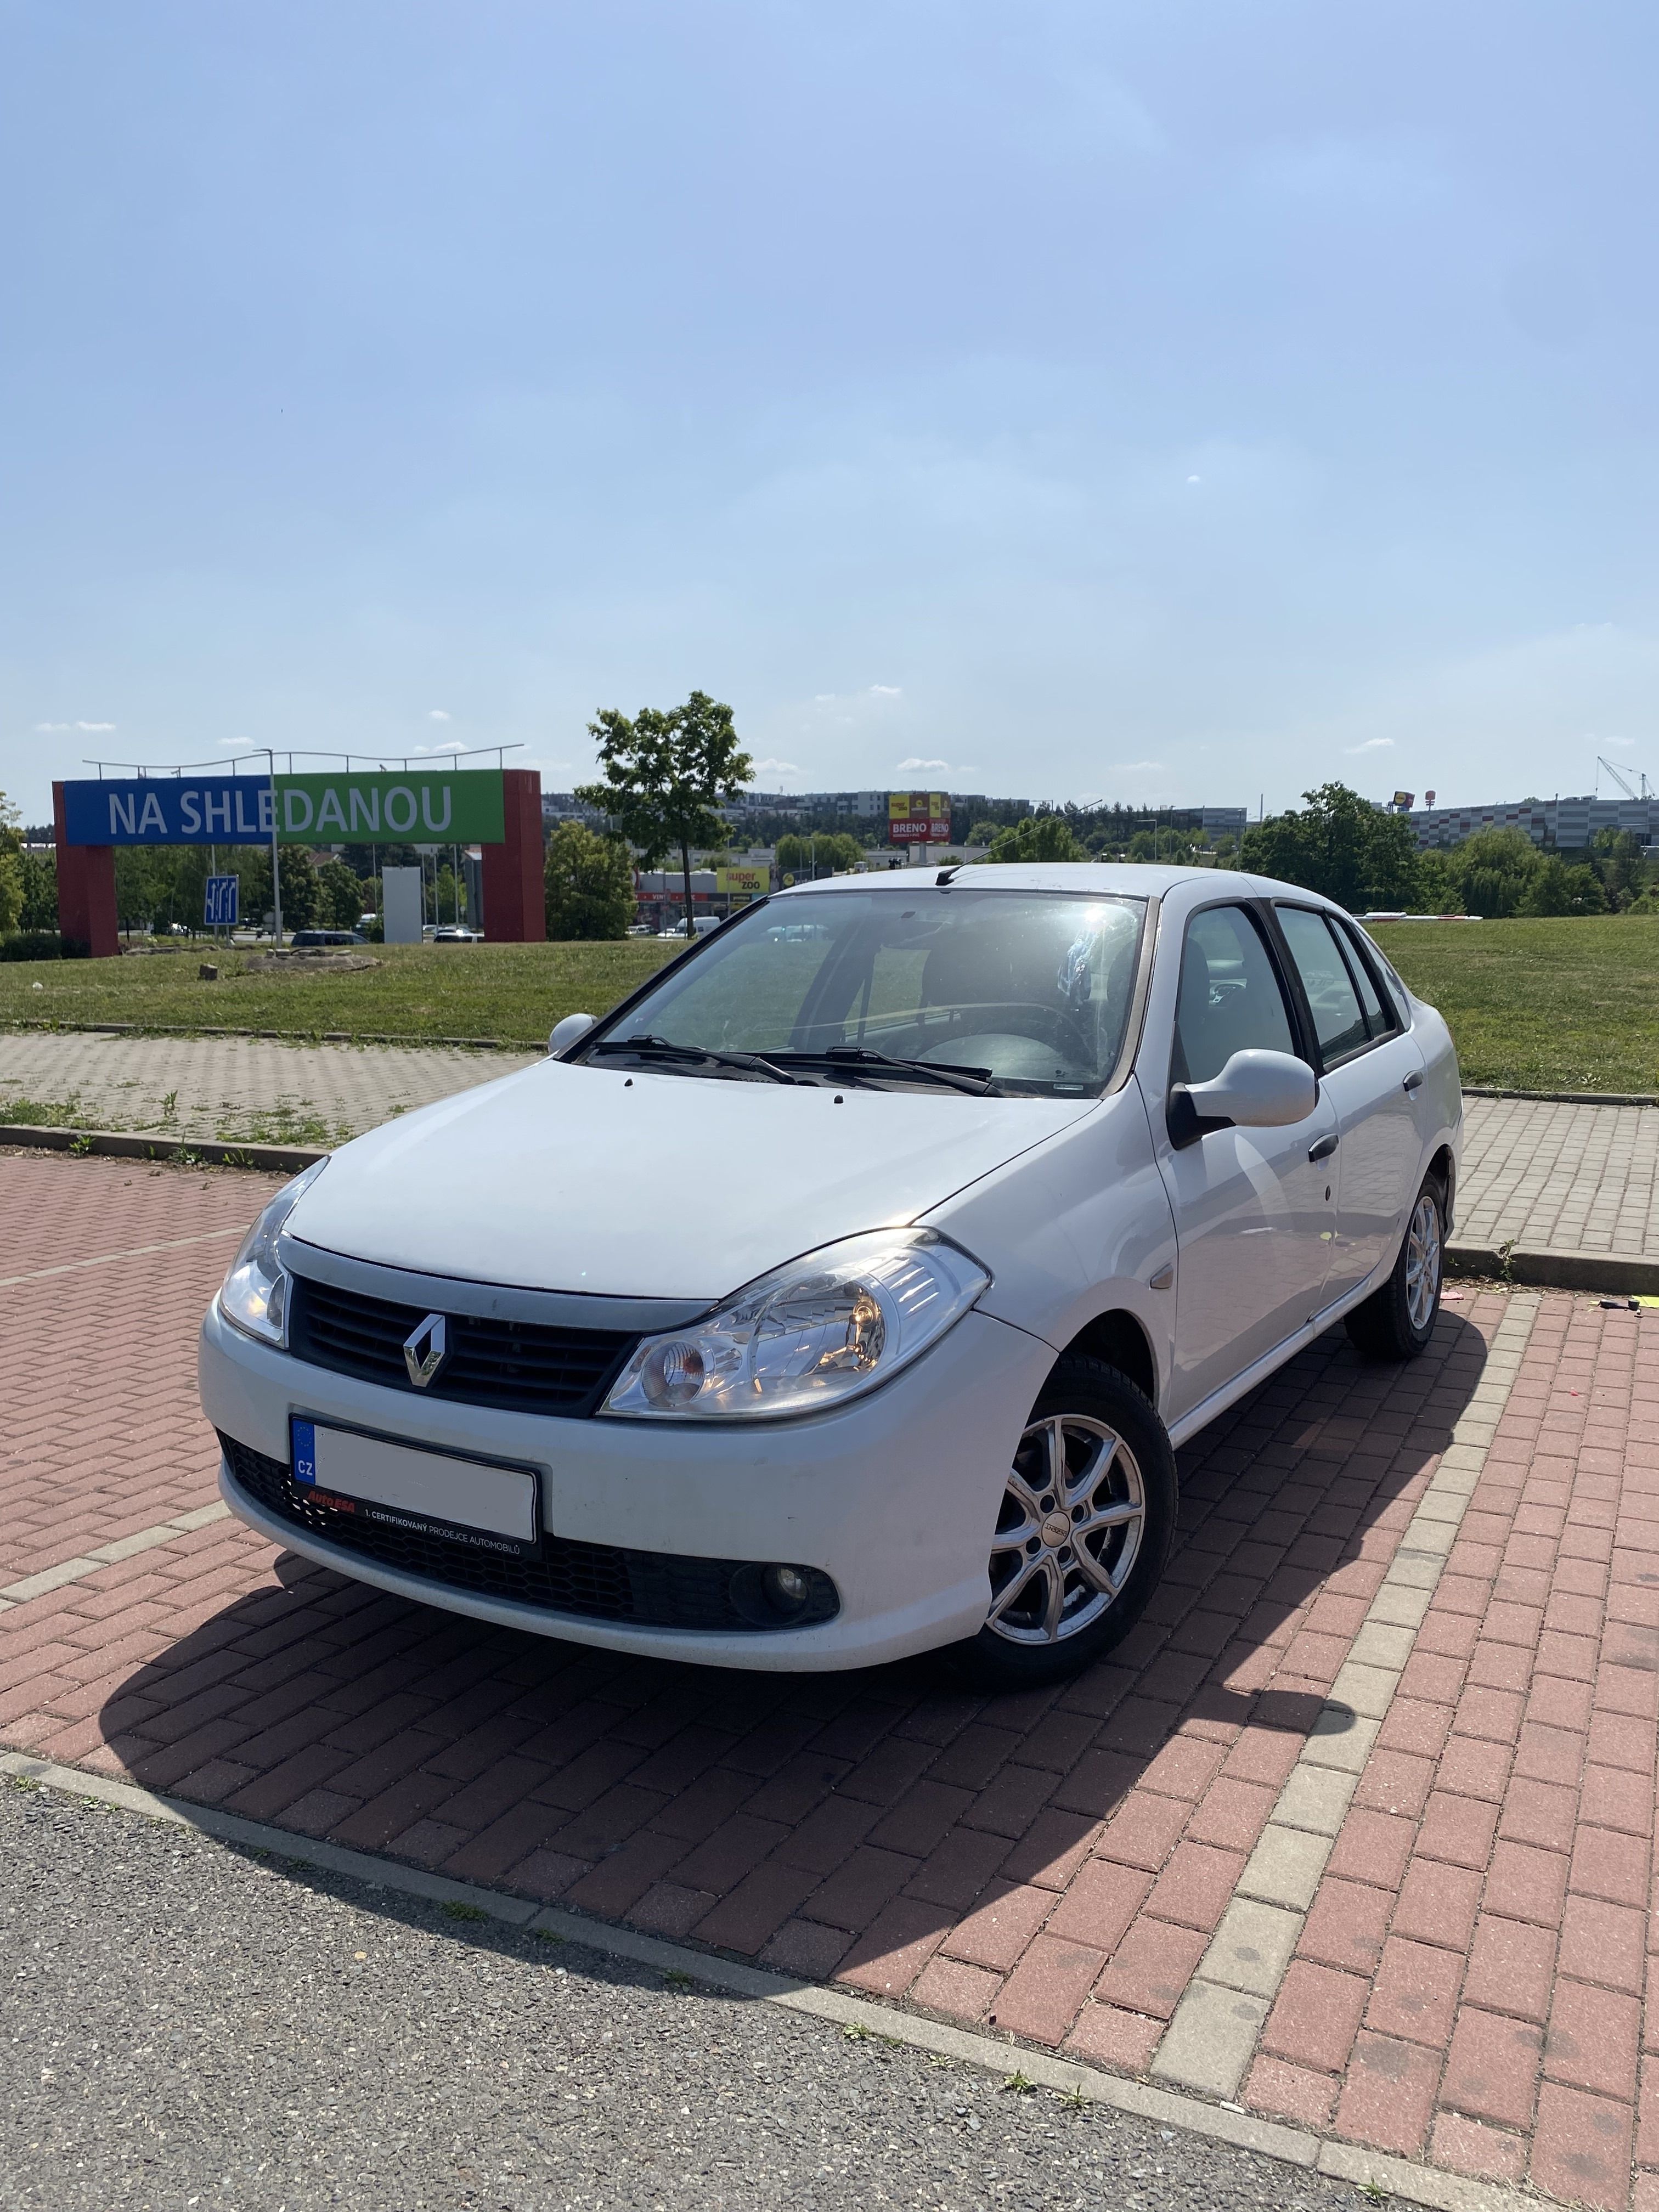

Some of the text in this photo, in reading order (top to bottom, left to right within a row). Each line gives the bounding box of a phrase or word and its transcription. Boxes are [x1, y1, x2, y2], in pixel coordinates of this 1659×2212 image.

[109, 786, 452, 834] NA SHLEDANOU
[893, 823, 927, 833] BRENO
[932, 823, 949, 833] BRENO
[726, 872, 756, 882] super
[298, 1460, 313, 1476] CZ
[371, 1511, 428, 1532] CERTIFIKOVANÝ
[429, 1525, 468, 1543] PRODEJCE
[470, 1536, 520, 1555] AUTOMOBILŮ
